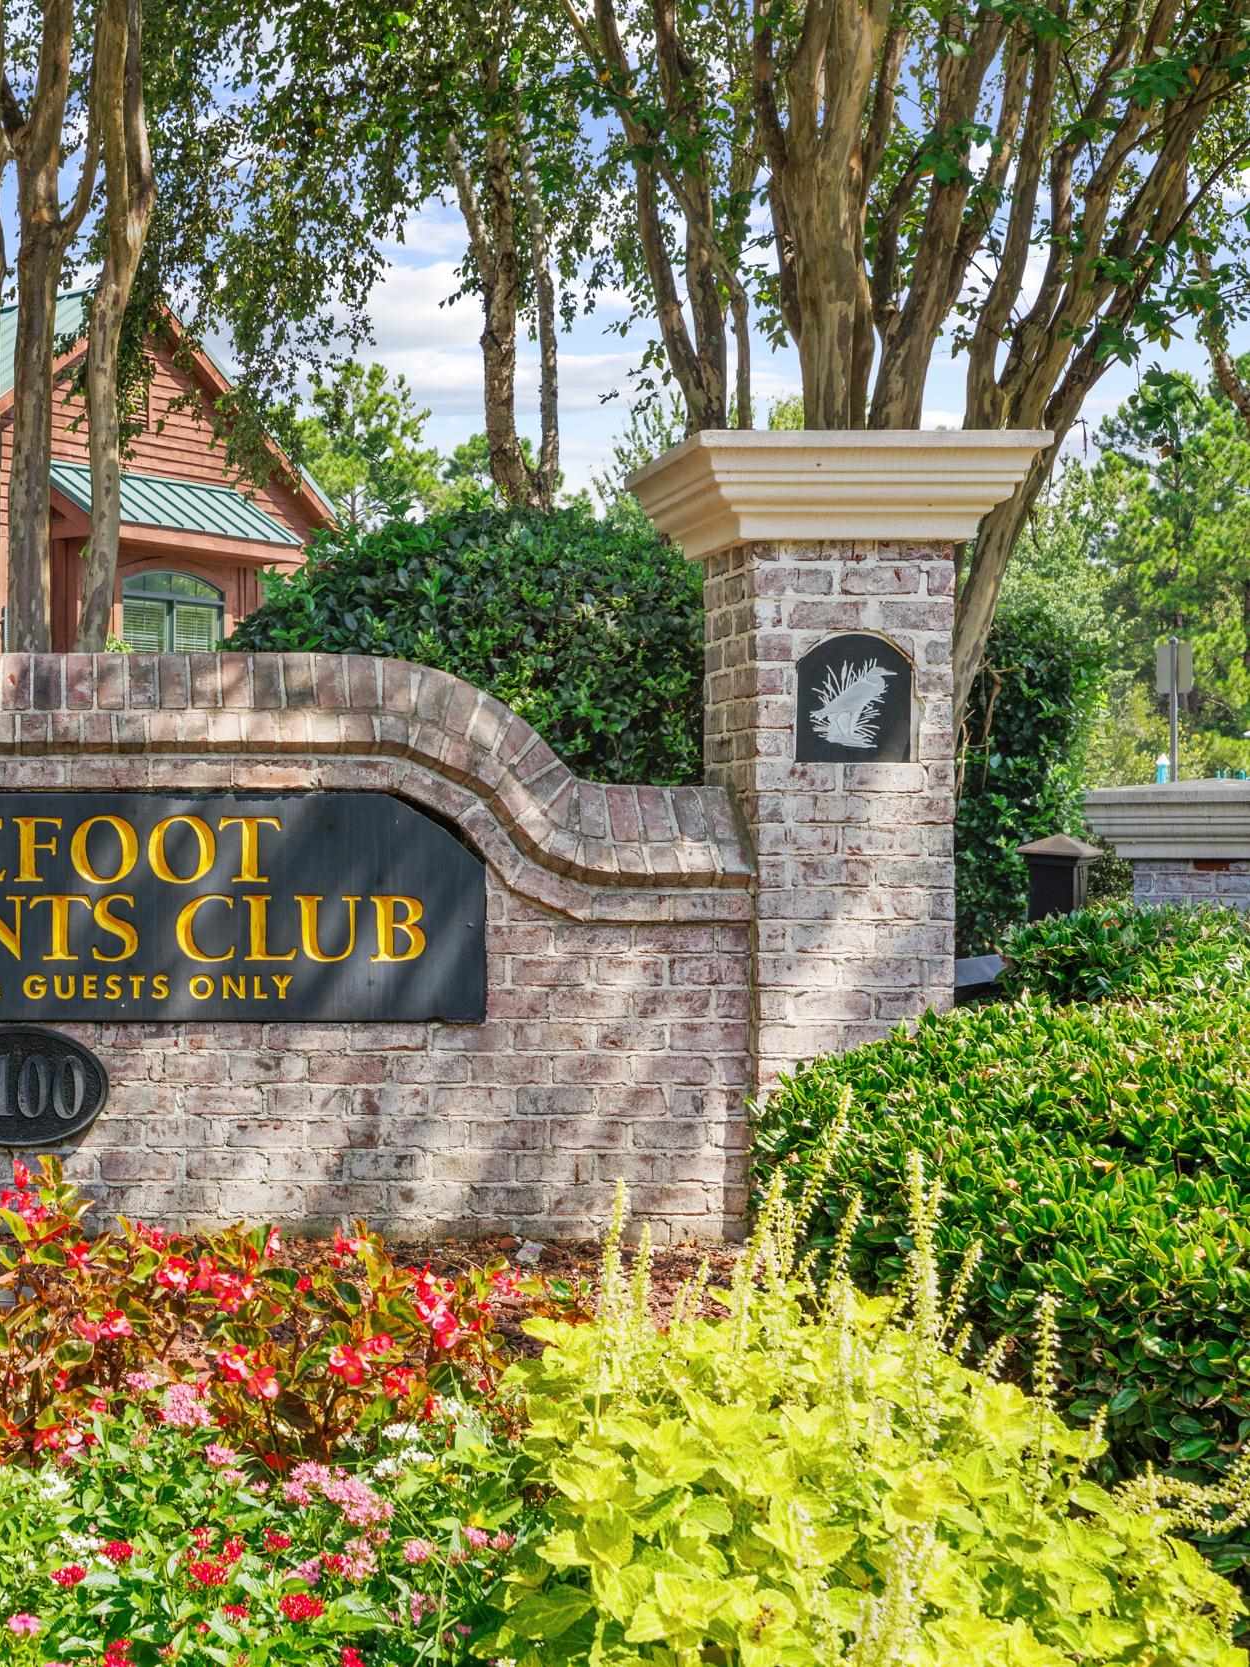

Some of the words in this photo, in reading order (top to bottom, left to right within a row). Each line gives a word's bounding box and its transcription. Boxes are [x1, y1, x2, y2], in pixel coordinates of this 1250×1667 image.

[173, 893, 428, 964] CLUB
[22, 973, 170, 1001] GUESTS
[188, 973, 294, 1001] ONLY
